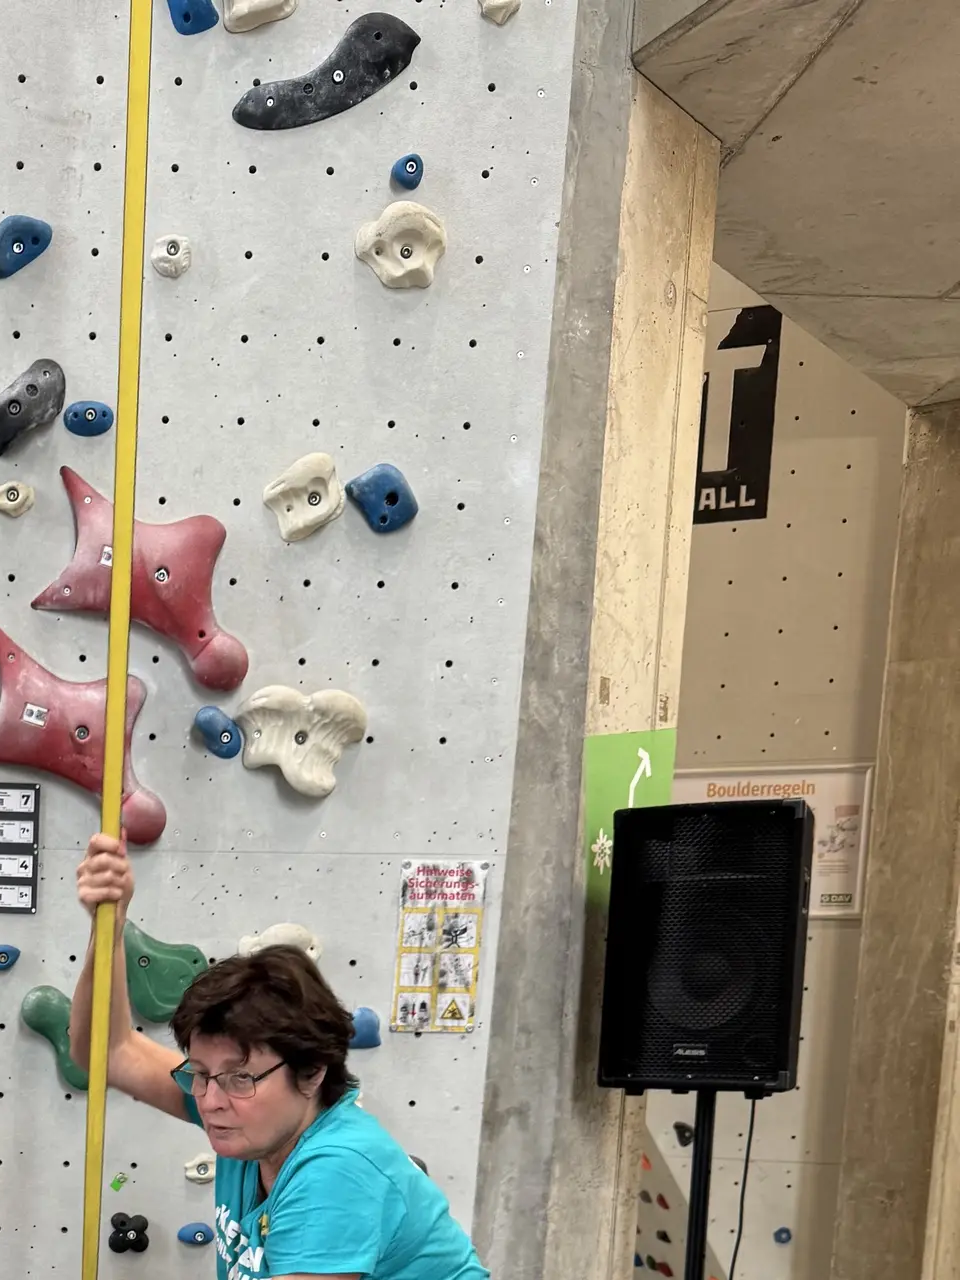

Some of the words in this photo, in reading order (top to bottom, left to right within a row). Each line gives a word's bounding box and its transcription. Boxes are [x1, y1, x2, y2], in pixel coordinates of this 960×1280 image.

[707, 780, 816, 798] Boulderregeln
[22, 794, 31, 805] 7
[20, 860, 28, 870] 4
[417, 867, 473, 878] Hinweise
[408, 878, 479, 891] Sicherungs-
[409, 889, 476, 901] automaten
